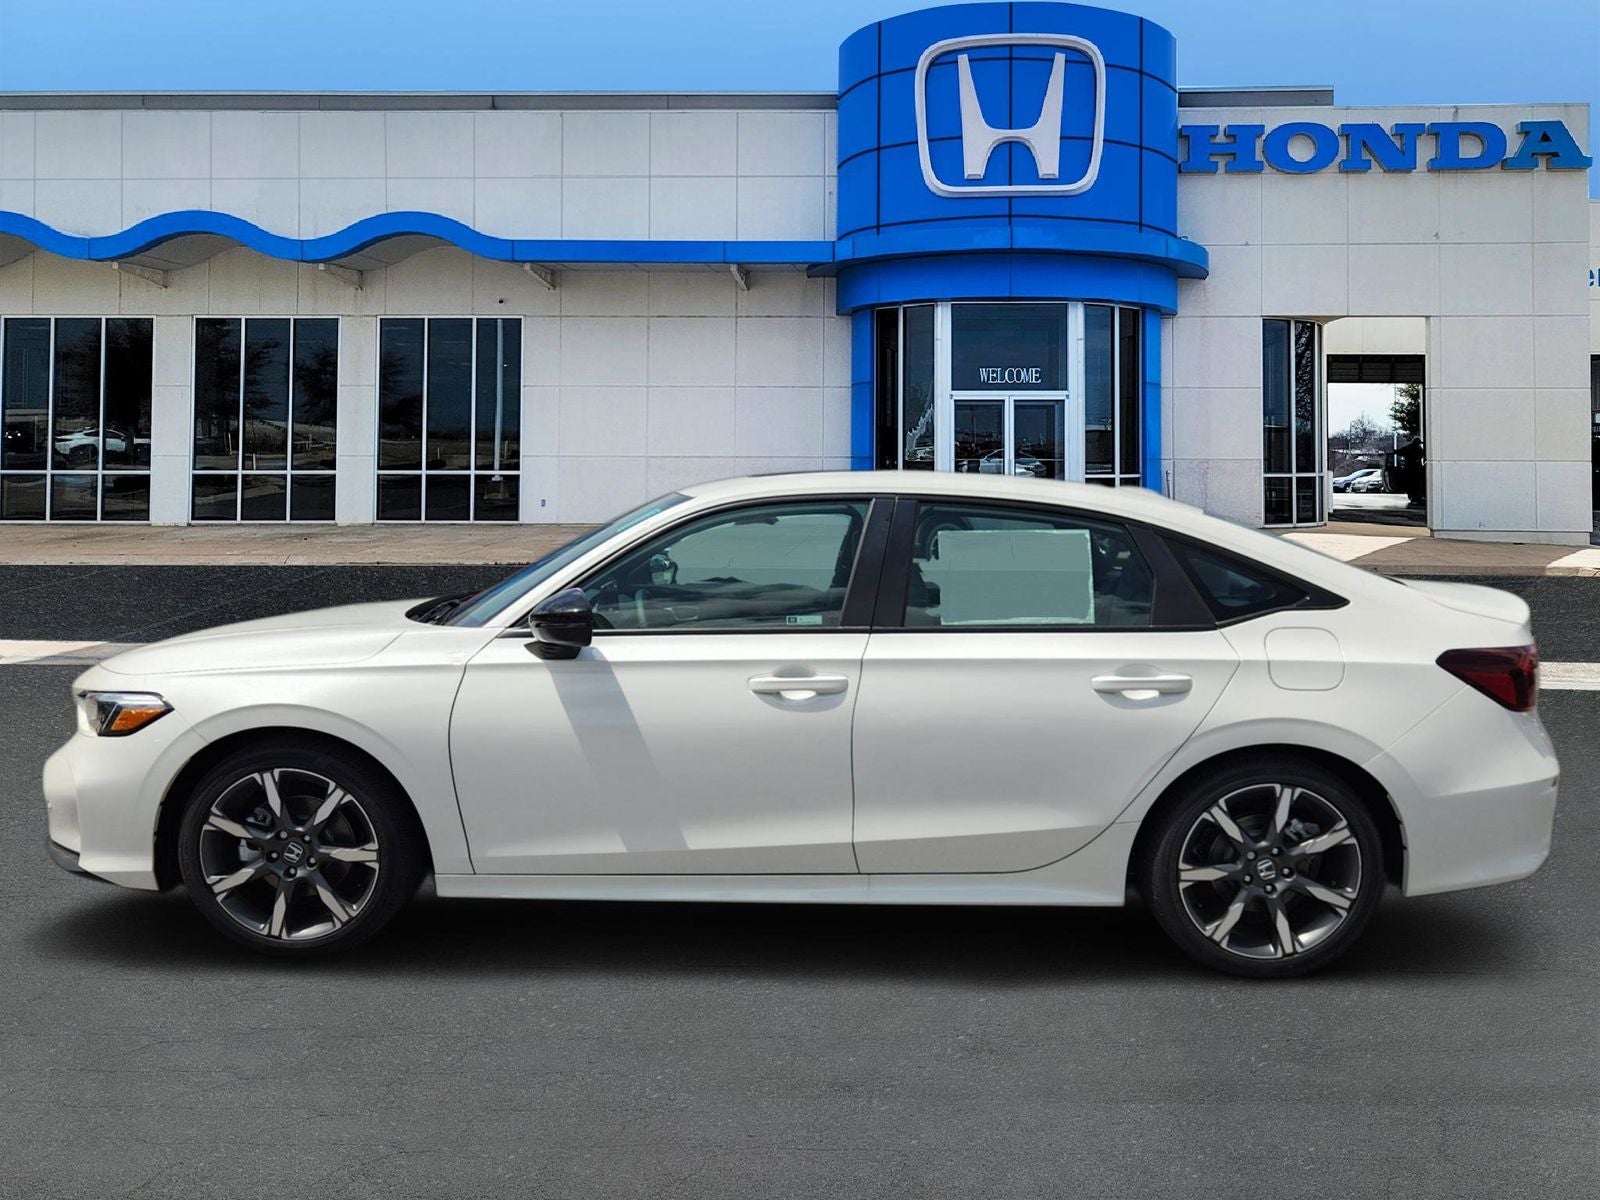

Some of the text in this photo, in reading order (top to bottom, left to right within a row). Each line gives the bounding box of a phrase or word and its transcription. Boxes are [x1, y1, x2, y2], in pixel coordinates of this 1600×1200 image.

[957, 52, 1066, 180] H
[1180, 120, 1593, 174] HONDA
[979, 367, 1041, 384] WELCOME
